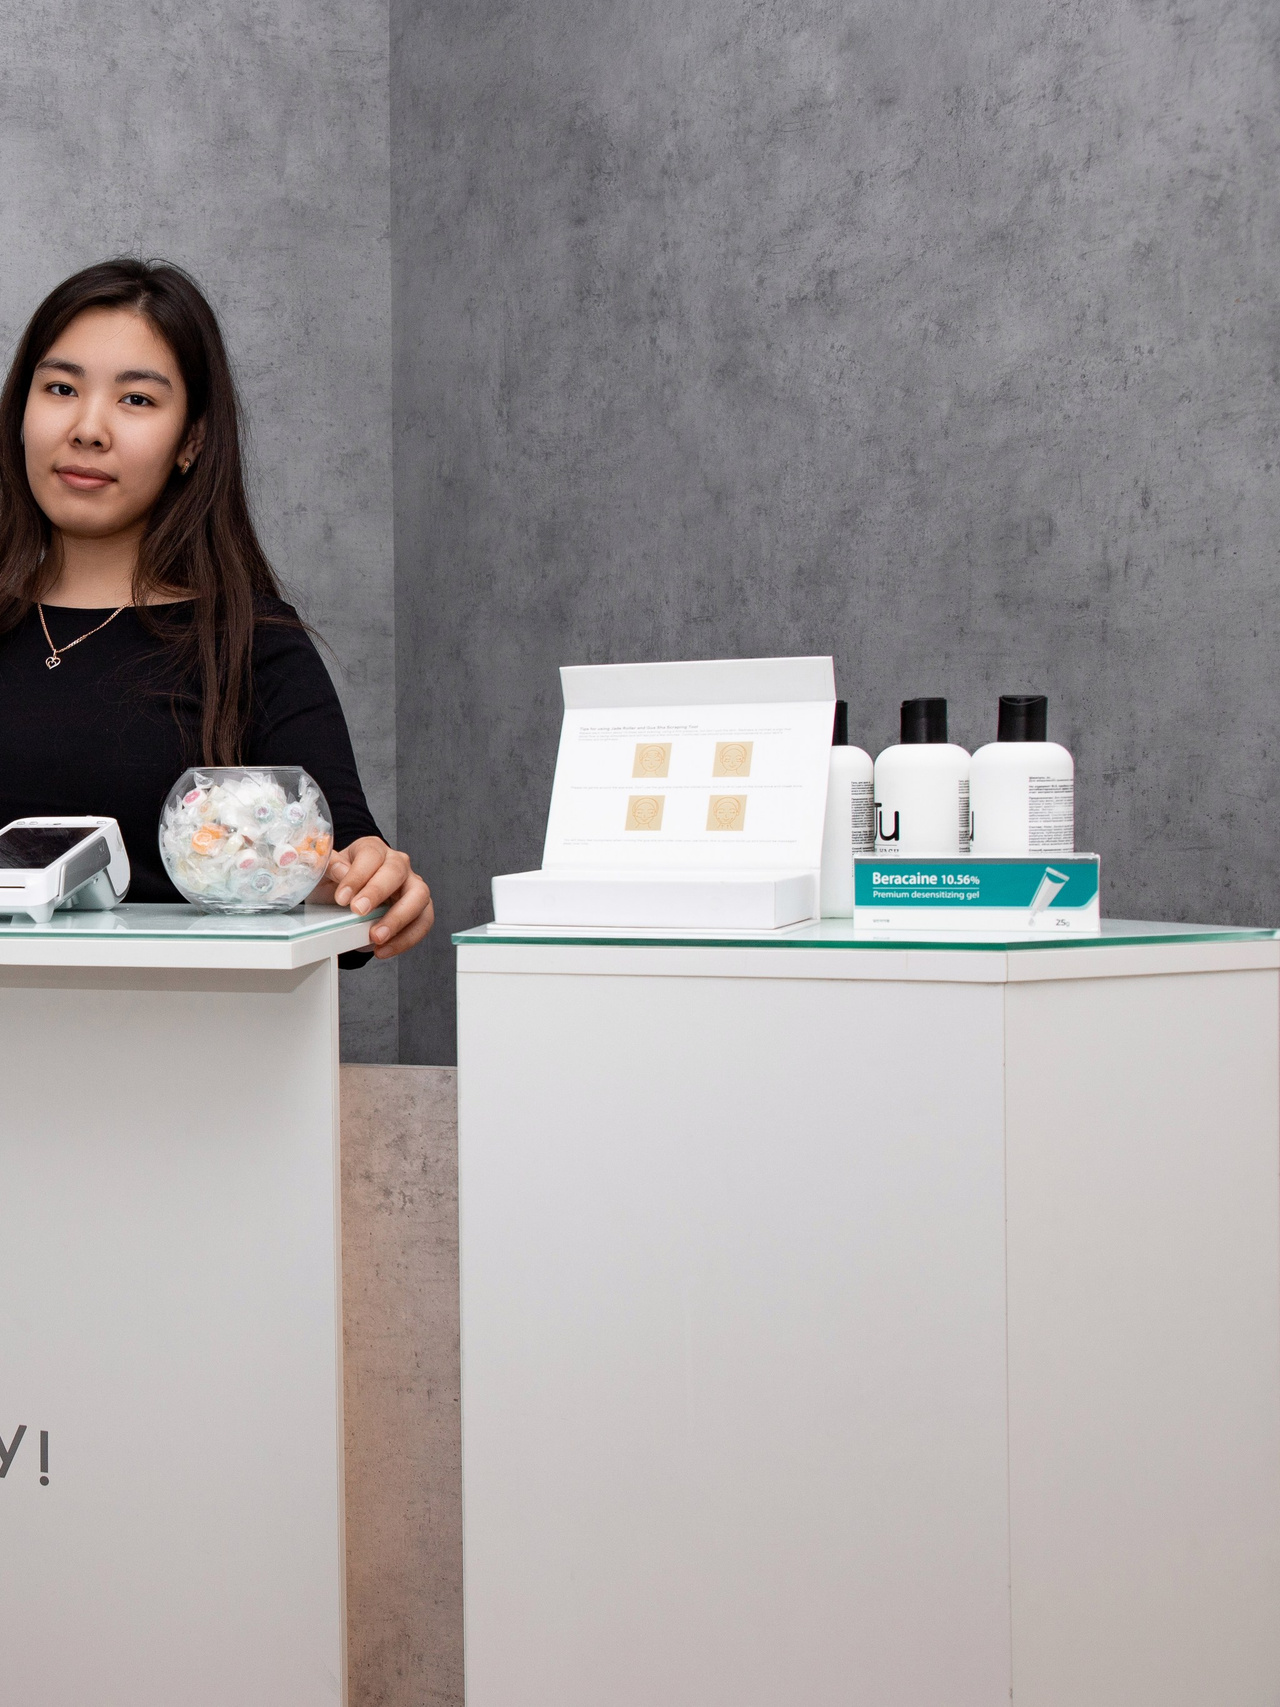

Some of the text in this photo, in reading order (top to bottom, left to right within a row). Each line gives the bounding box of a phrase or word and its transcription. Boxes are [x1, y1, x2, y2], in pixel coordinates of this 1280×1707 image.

[872, 872, 980, 886] Beracaine 10.56%
[872, 890, 980, 901] Premium desensitizing gel
[1056, 918, 1071, 928] 25g
